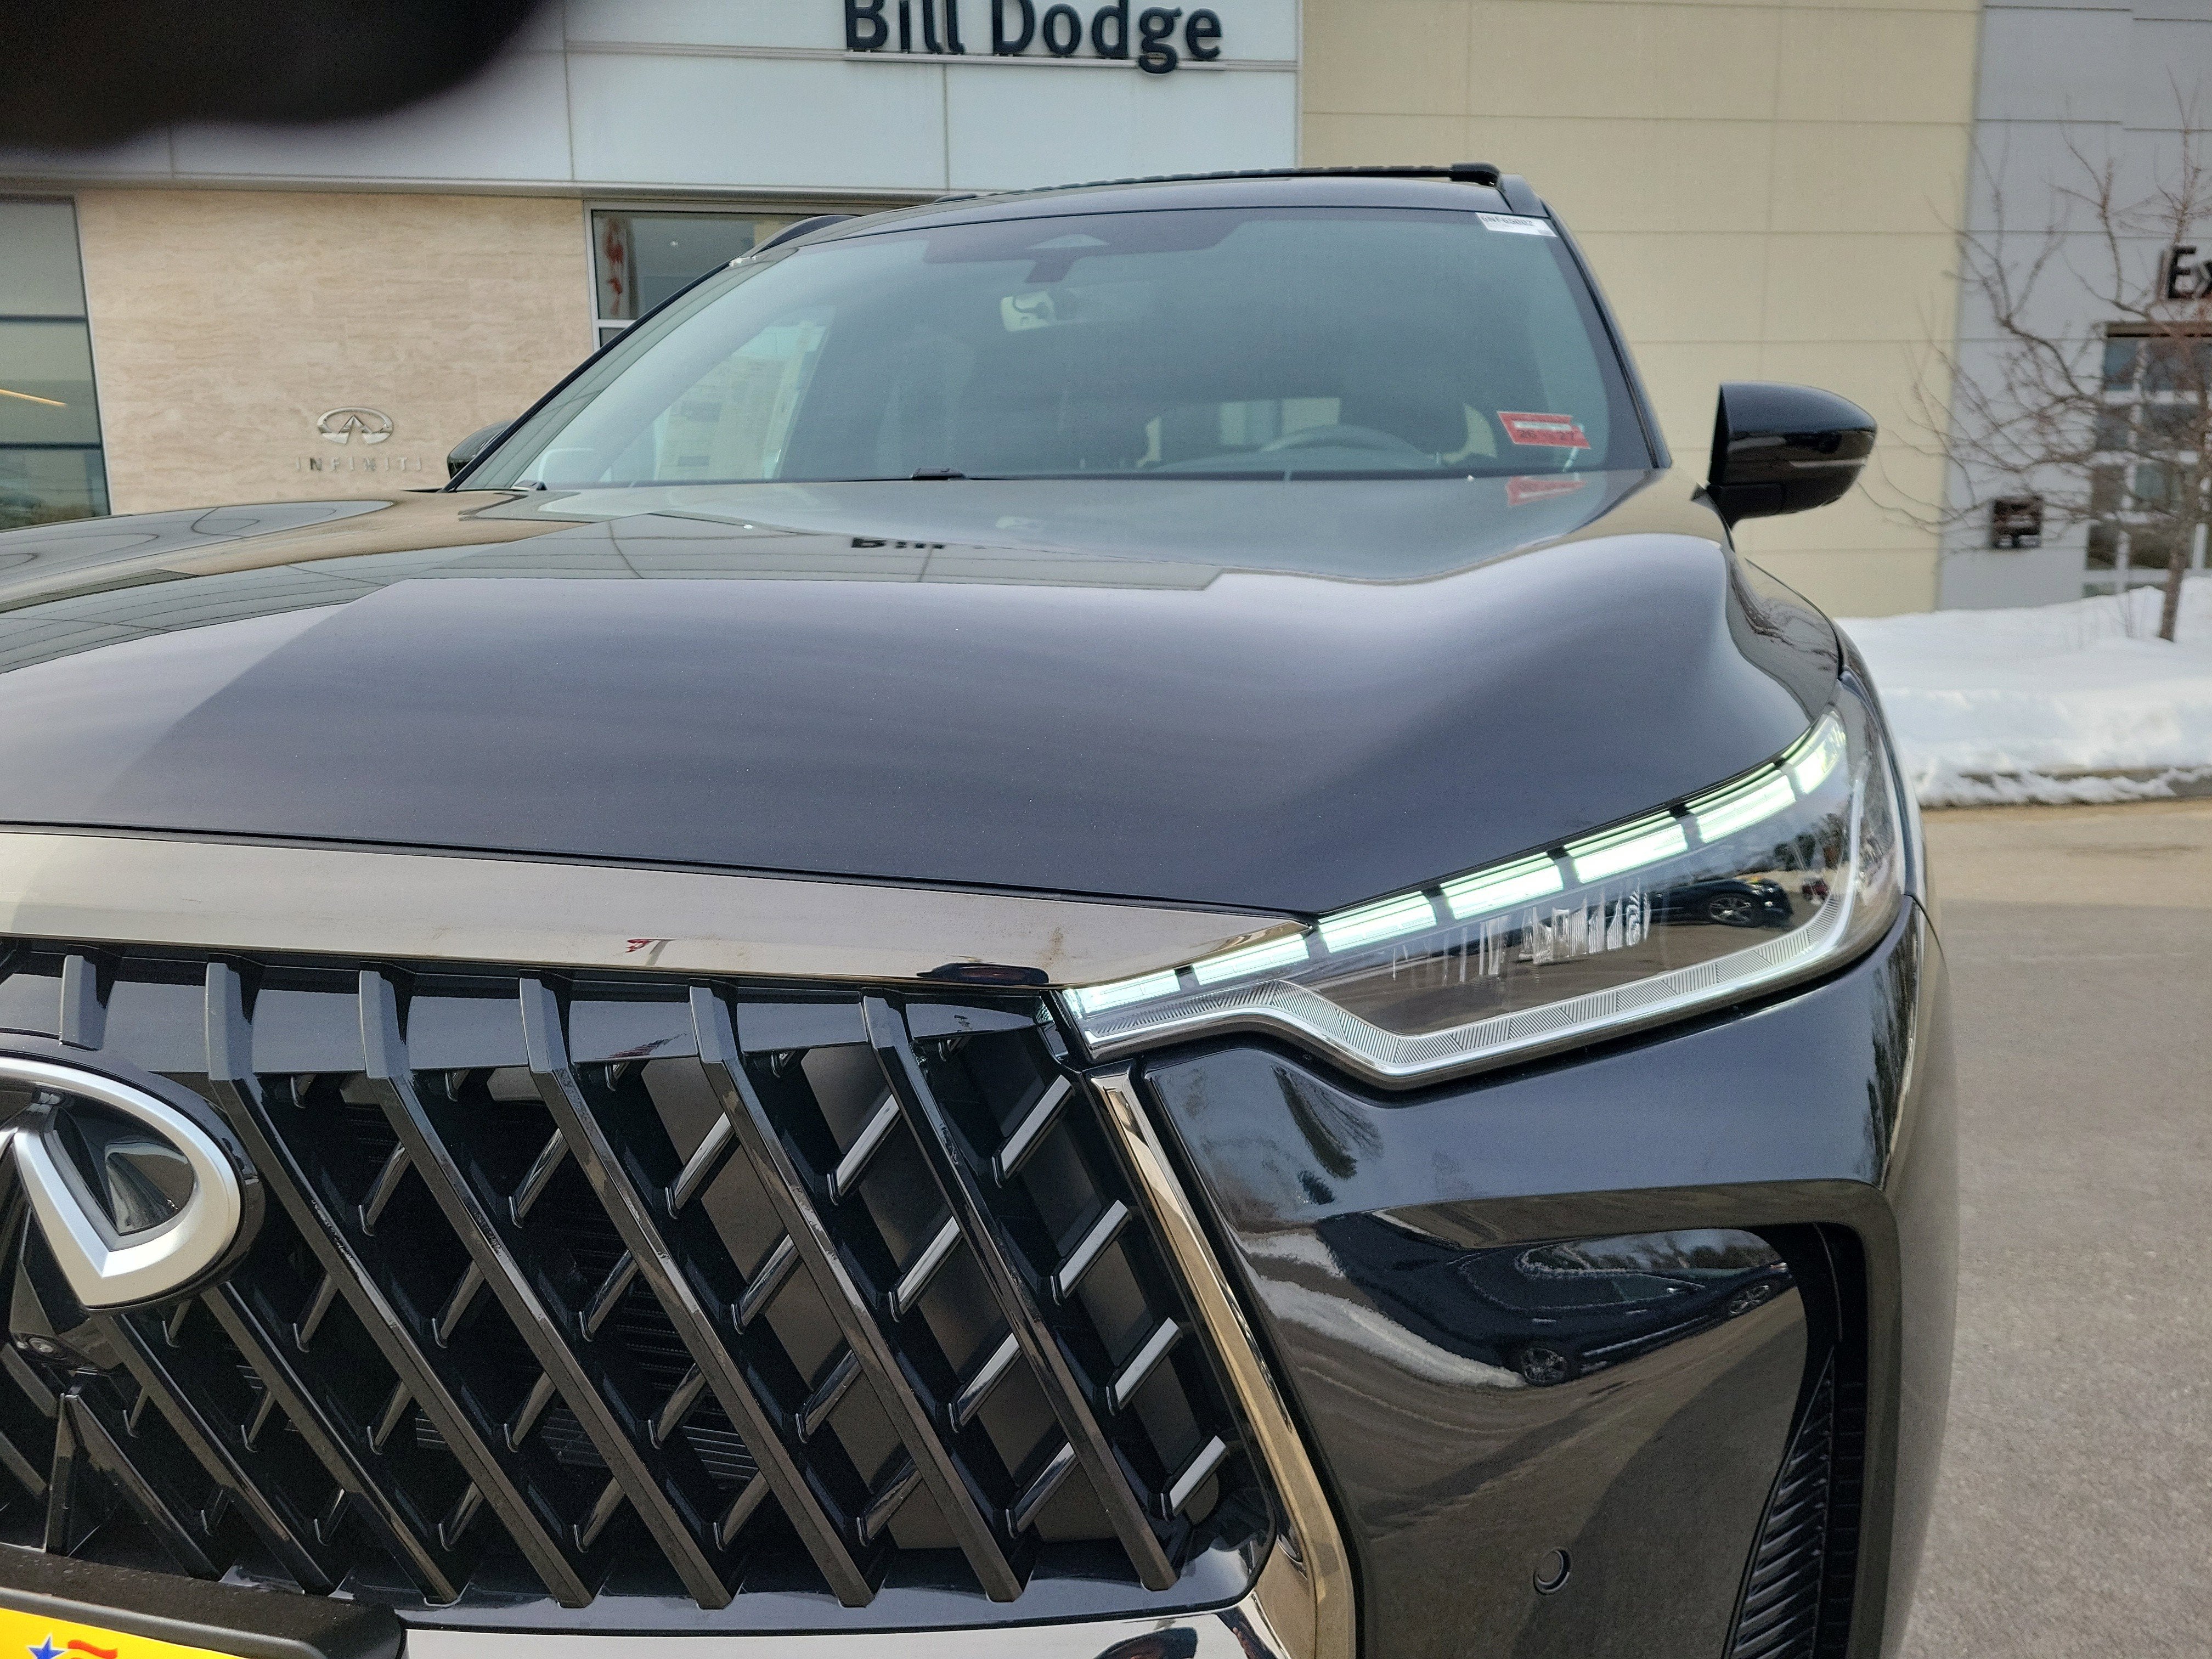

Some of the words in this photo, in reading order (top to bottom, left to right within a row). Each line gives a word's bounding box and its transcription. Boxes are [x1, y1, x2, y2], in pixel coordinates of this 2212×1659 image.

[845, 0, 965, 54] Bill
[992, 0, 1223, 74] Dodge
[295, 456, 422, 471] INFINITI
